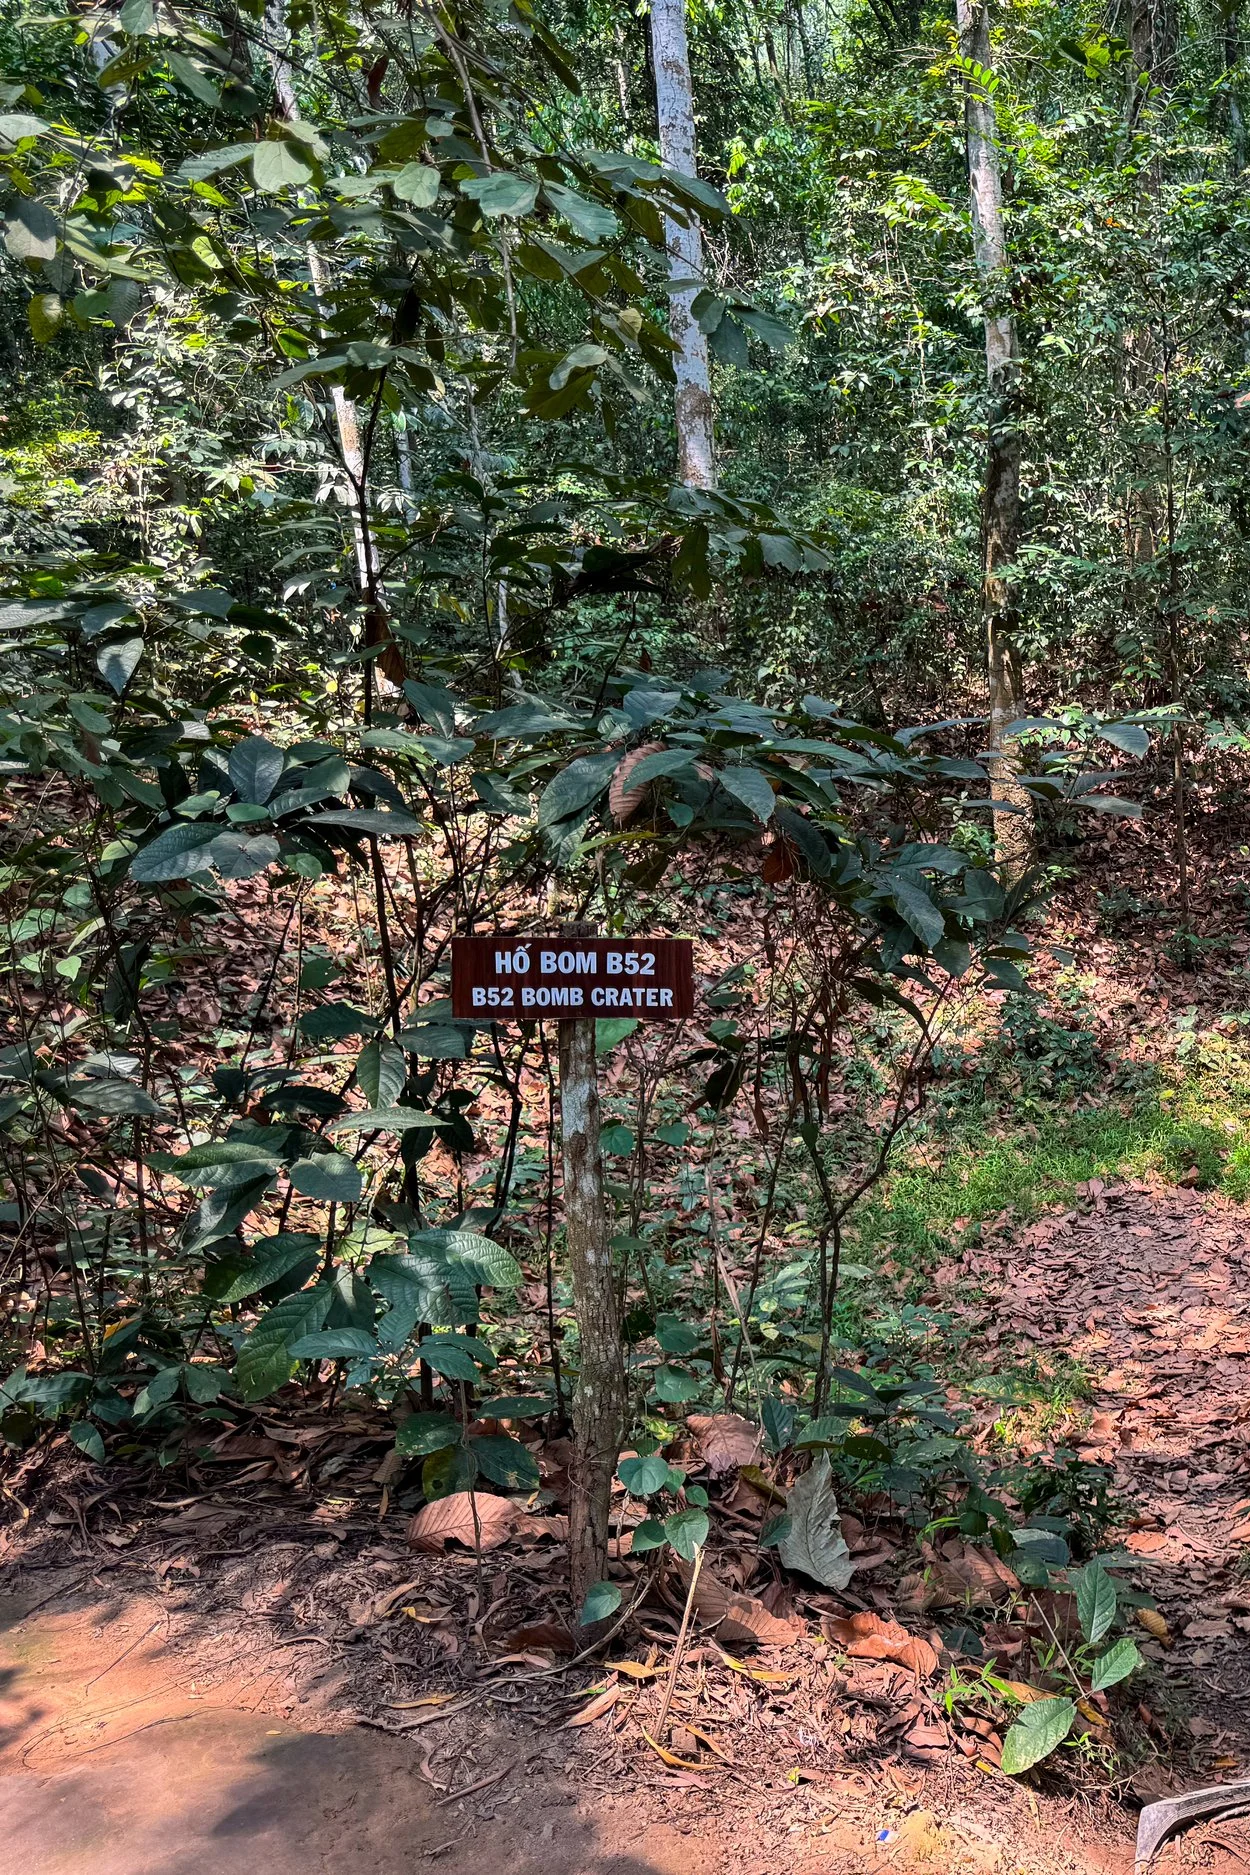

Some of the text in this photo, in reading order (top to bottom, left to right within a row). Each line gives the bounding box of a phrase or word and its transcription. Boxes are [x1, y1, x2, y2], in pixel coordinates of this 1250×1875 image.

[494, 943, 656, 975] HỐ BOM B52
[472, 987, 674, 1007] B52 BOMB CRATER
